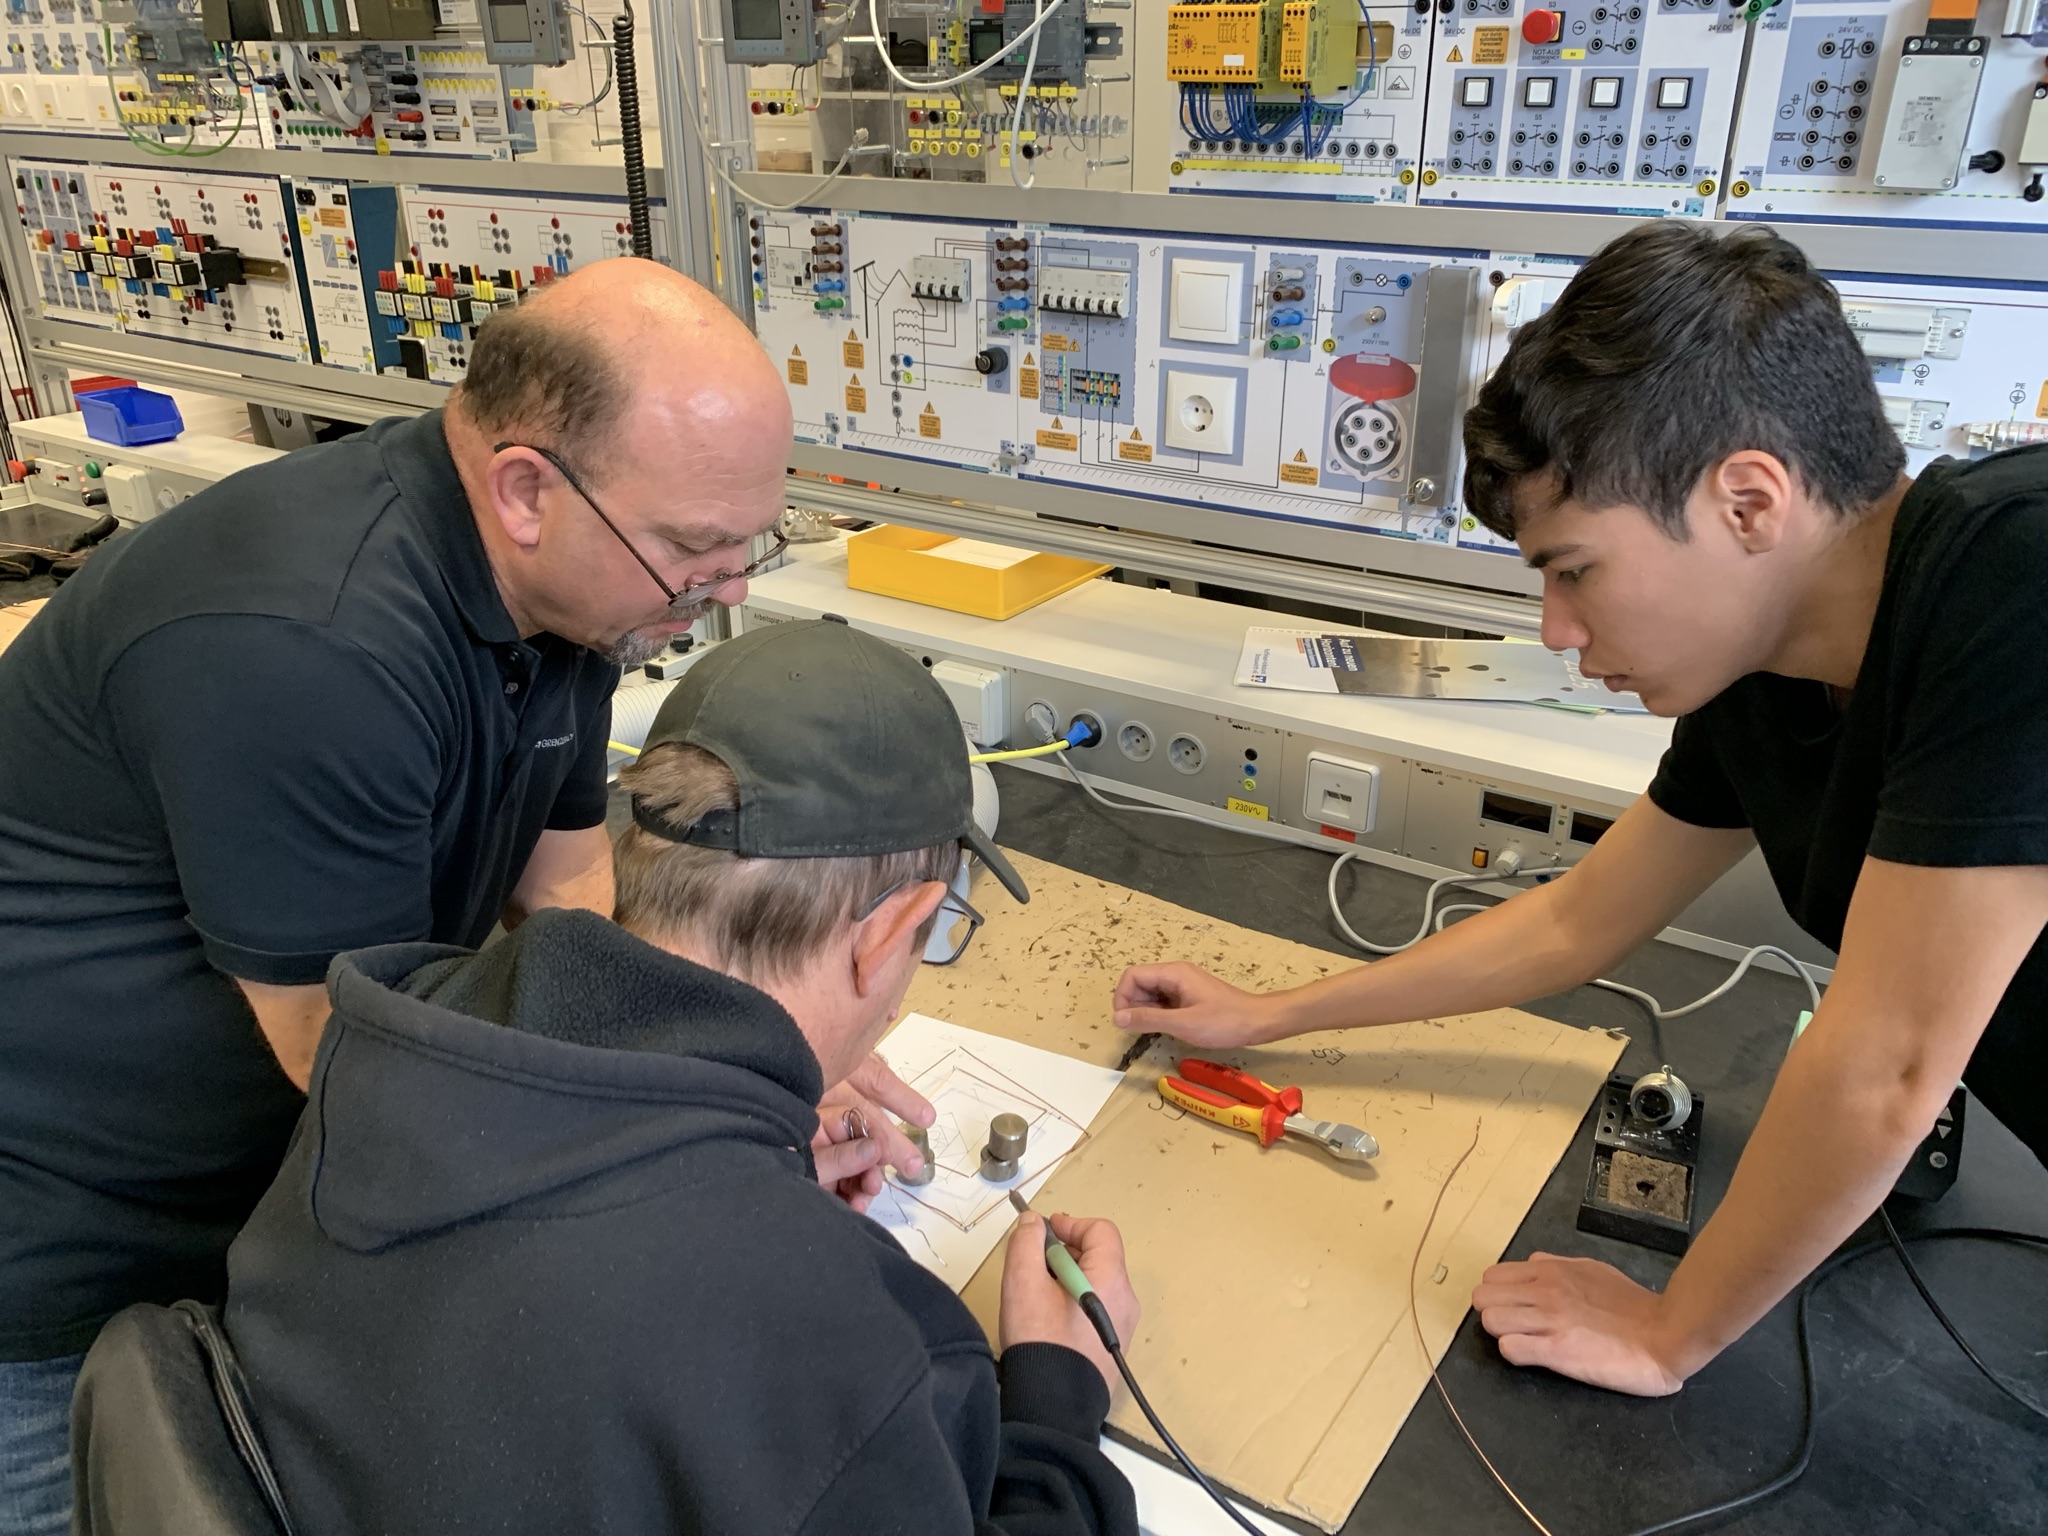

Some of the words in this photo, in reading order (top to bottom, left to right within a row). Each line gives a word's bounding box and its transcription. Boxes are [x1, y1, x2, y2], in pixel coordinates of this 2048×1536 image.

[1320, 638, 1340, 668] Horizonten!
[1338, 638, 1353, 648] Auf
[1344, 655, 1358, 672] neuen
[1174, 1095, 1215, 1118] KNIPEX
